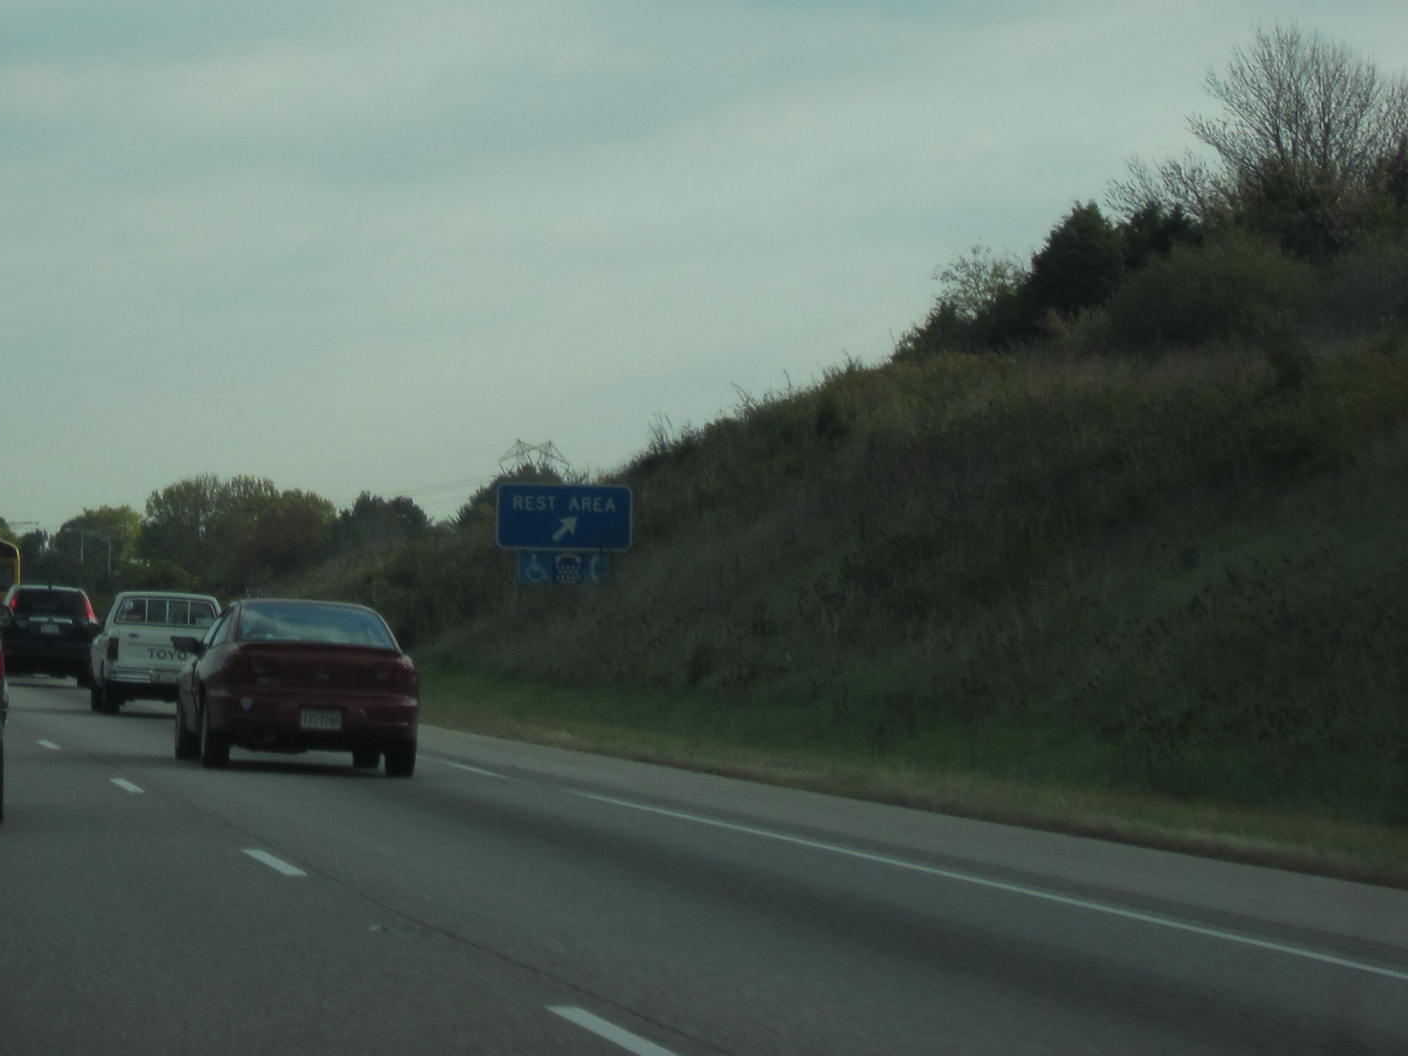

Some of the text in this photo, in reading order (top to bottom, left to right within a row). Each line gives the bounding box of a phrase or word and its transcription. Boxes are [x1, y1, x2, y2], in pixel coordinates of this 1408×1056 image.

[513, 495, 616, 513] REST AREA
[147, 647, 189, 661] TOYO
